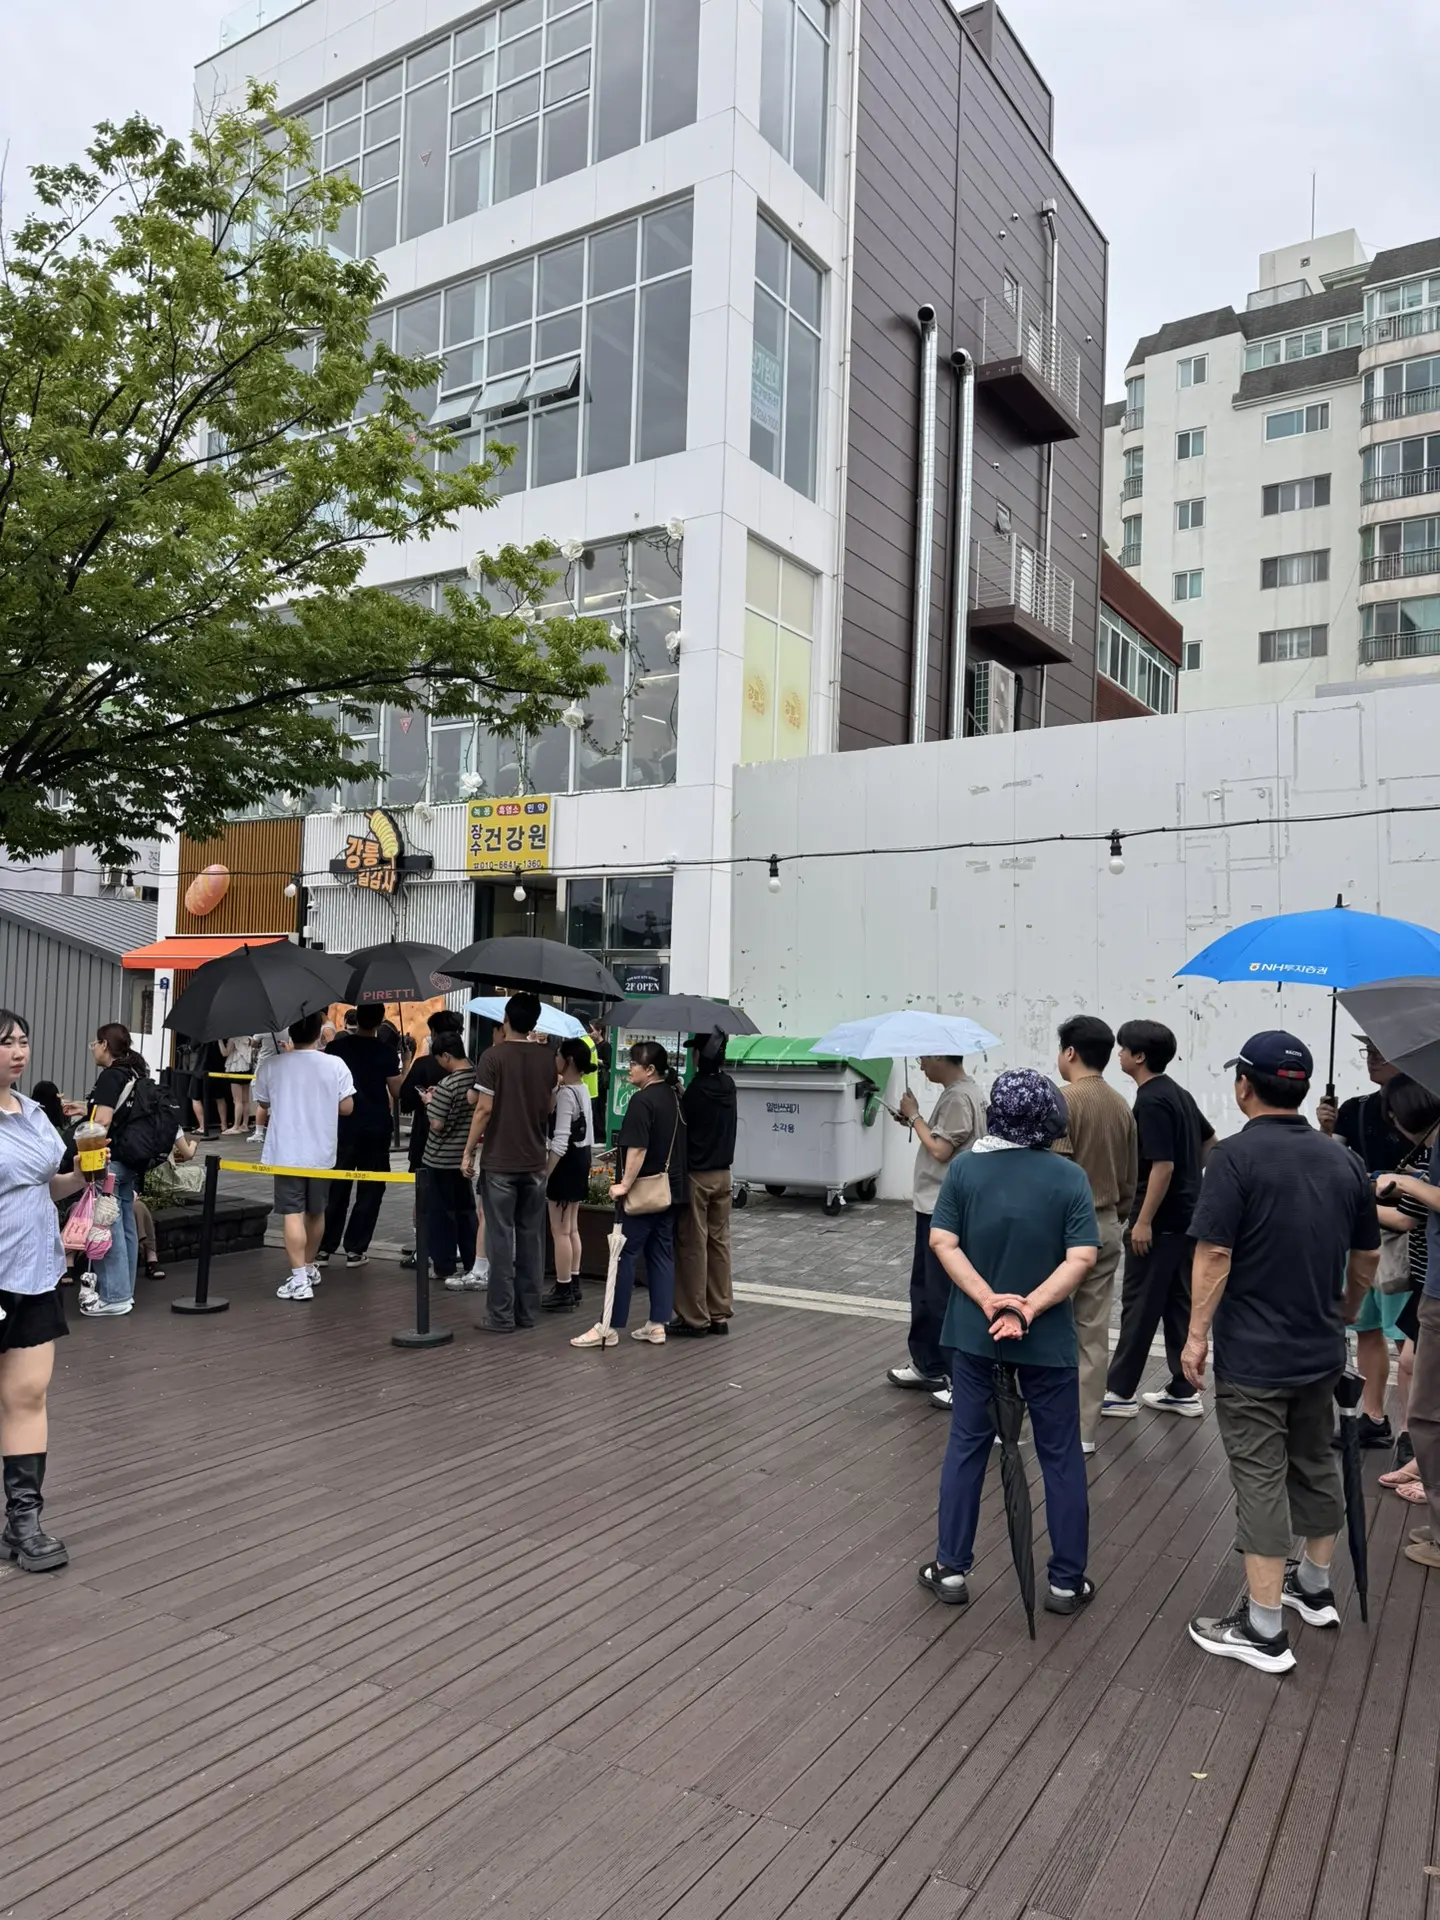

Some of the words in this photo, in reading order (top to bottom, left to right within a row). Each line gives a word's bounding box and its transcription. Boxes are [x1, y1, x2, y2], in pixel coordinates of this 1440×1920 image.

[484, 824, 547, 852] 건강원
[346, 836, 380, 869] 강릉
[625, 982, 636, 992] 2F
[636, 982, 660, 992] OPEN
[363, 988, 415, 1000] PIRETTI
[766, 1101, 800, 1114] 일반쓰레기
[772, 1123, 795, 1133] 소각용
